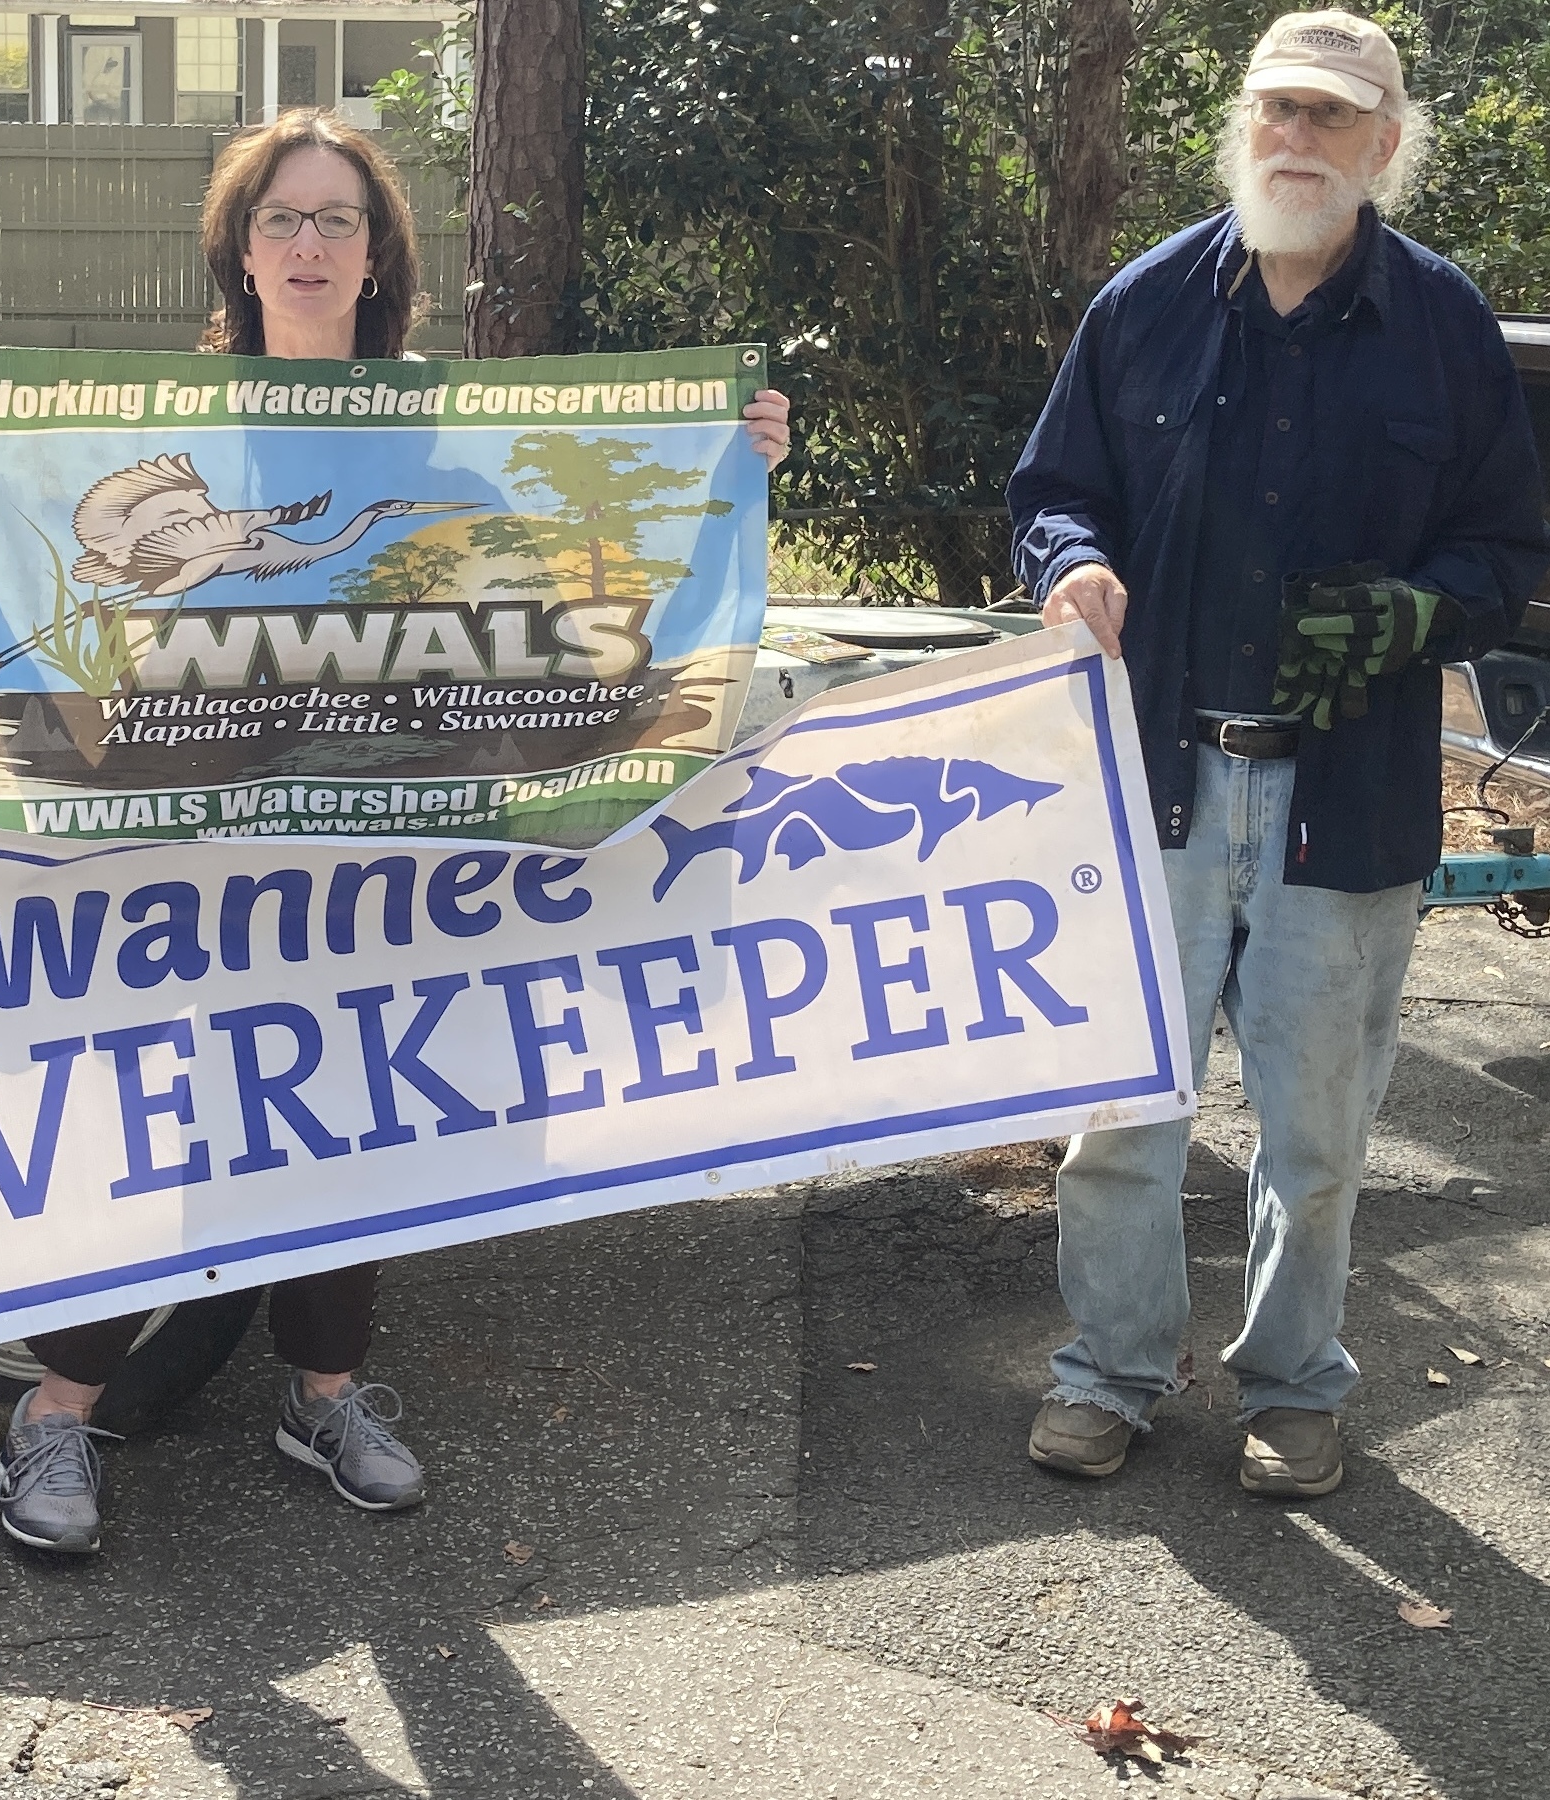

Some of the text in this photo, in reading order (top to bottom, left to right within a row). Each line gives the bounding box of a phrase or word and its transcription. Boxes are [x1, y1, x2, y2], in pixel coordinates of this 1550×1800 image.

[154, 379, 218, 416] For
[226, 380, 450, 416] Watershed
[454, 377, 729, 415] Conservation
[120, 604, 642, 690] WWALS
[98, 681, 645, 720] Withlacoochee Willacoochee
[98, 708, 620, 747] Alapaha Little Suwannee
[20, 757, 675, 834] WWALS Watershed Coalition
[196, 808, 500, 839] www.wwals.net
